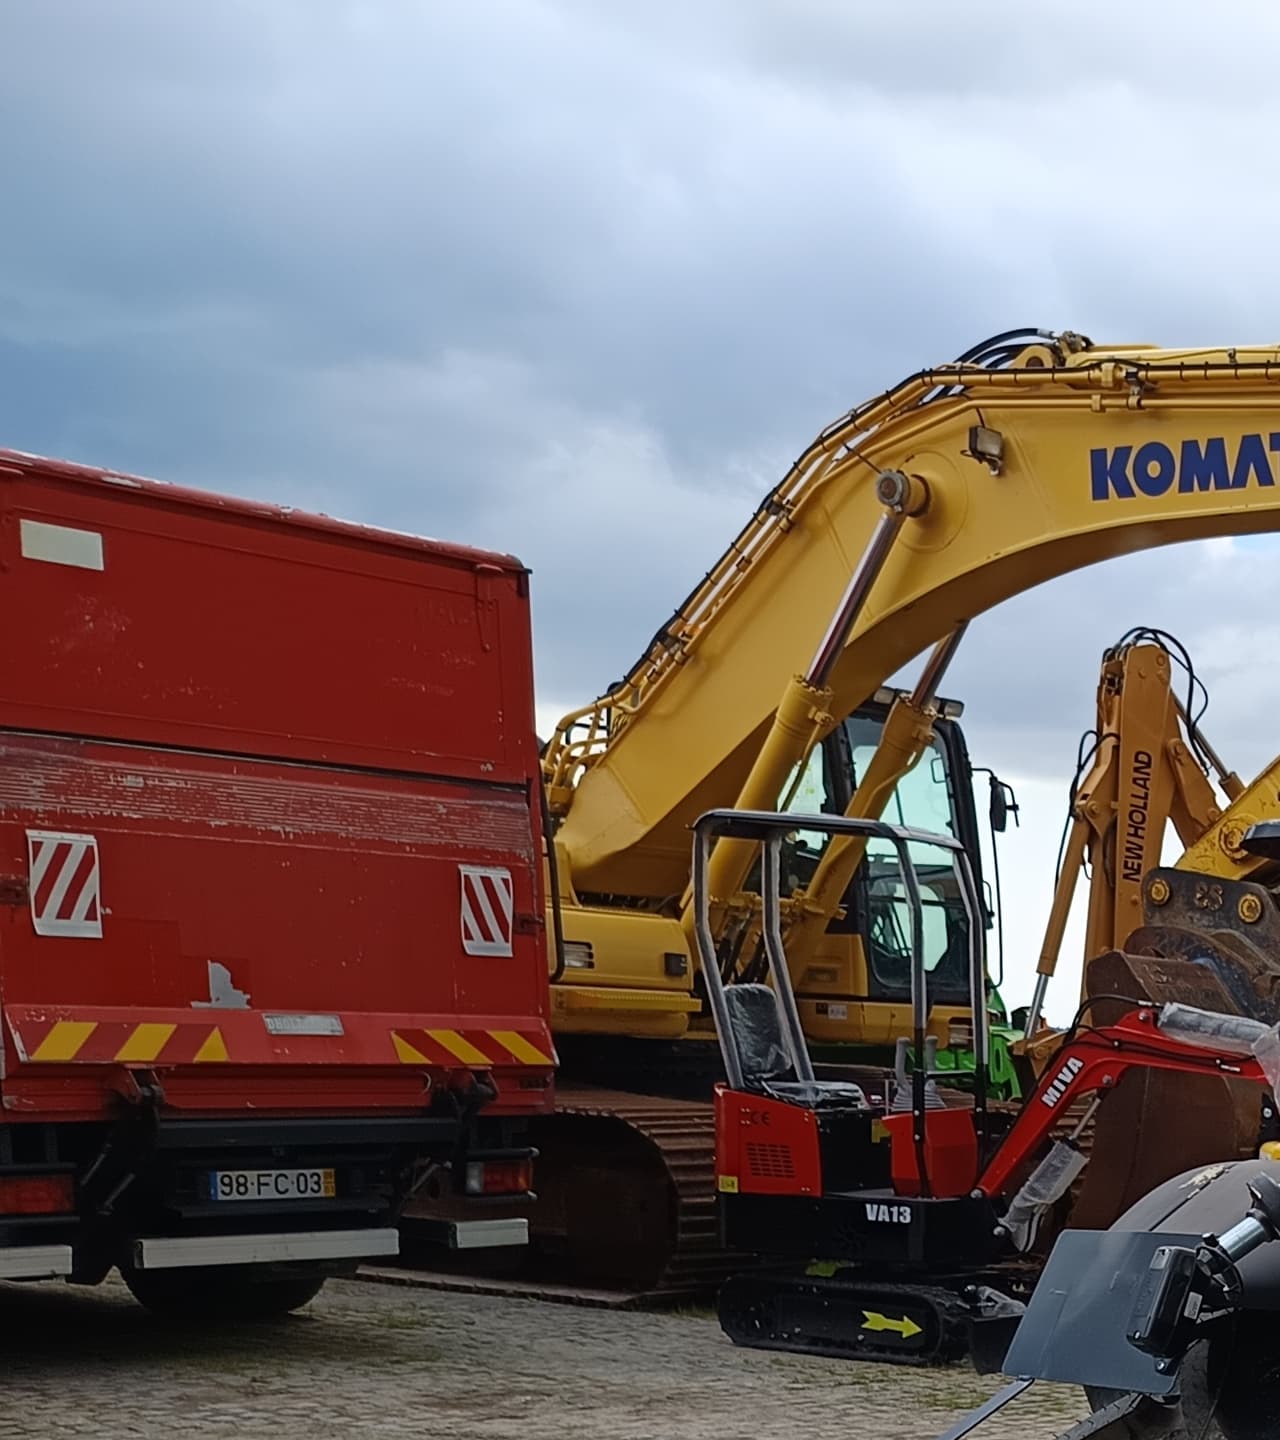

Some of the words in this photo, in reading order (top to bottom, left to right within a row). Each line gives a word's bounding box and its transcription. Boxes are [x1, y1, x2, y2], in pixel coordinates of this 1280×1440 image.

[1127, 750, 1153, 840] HOLLAND
[1122, 840, 1144, 882] NEW
[1041, 1056, 1084, 1108] MIVA
[865, 1203, 912, 1224] VA13
